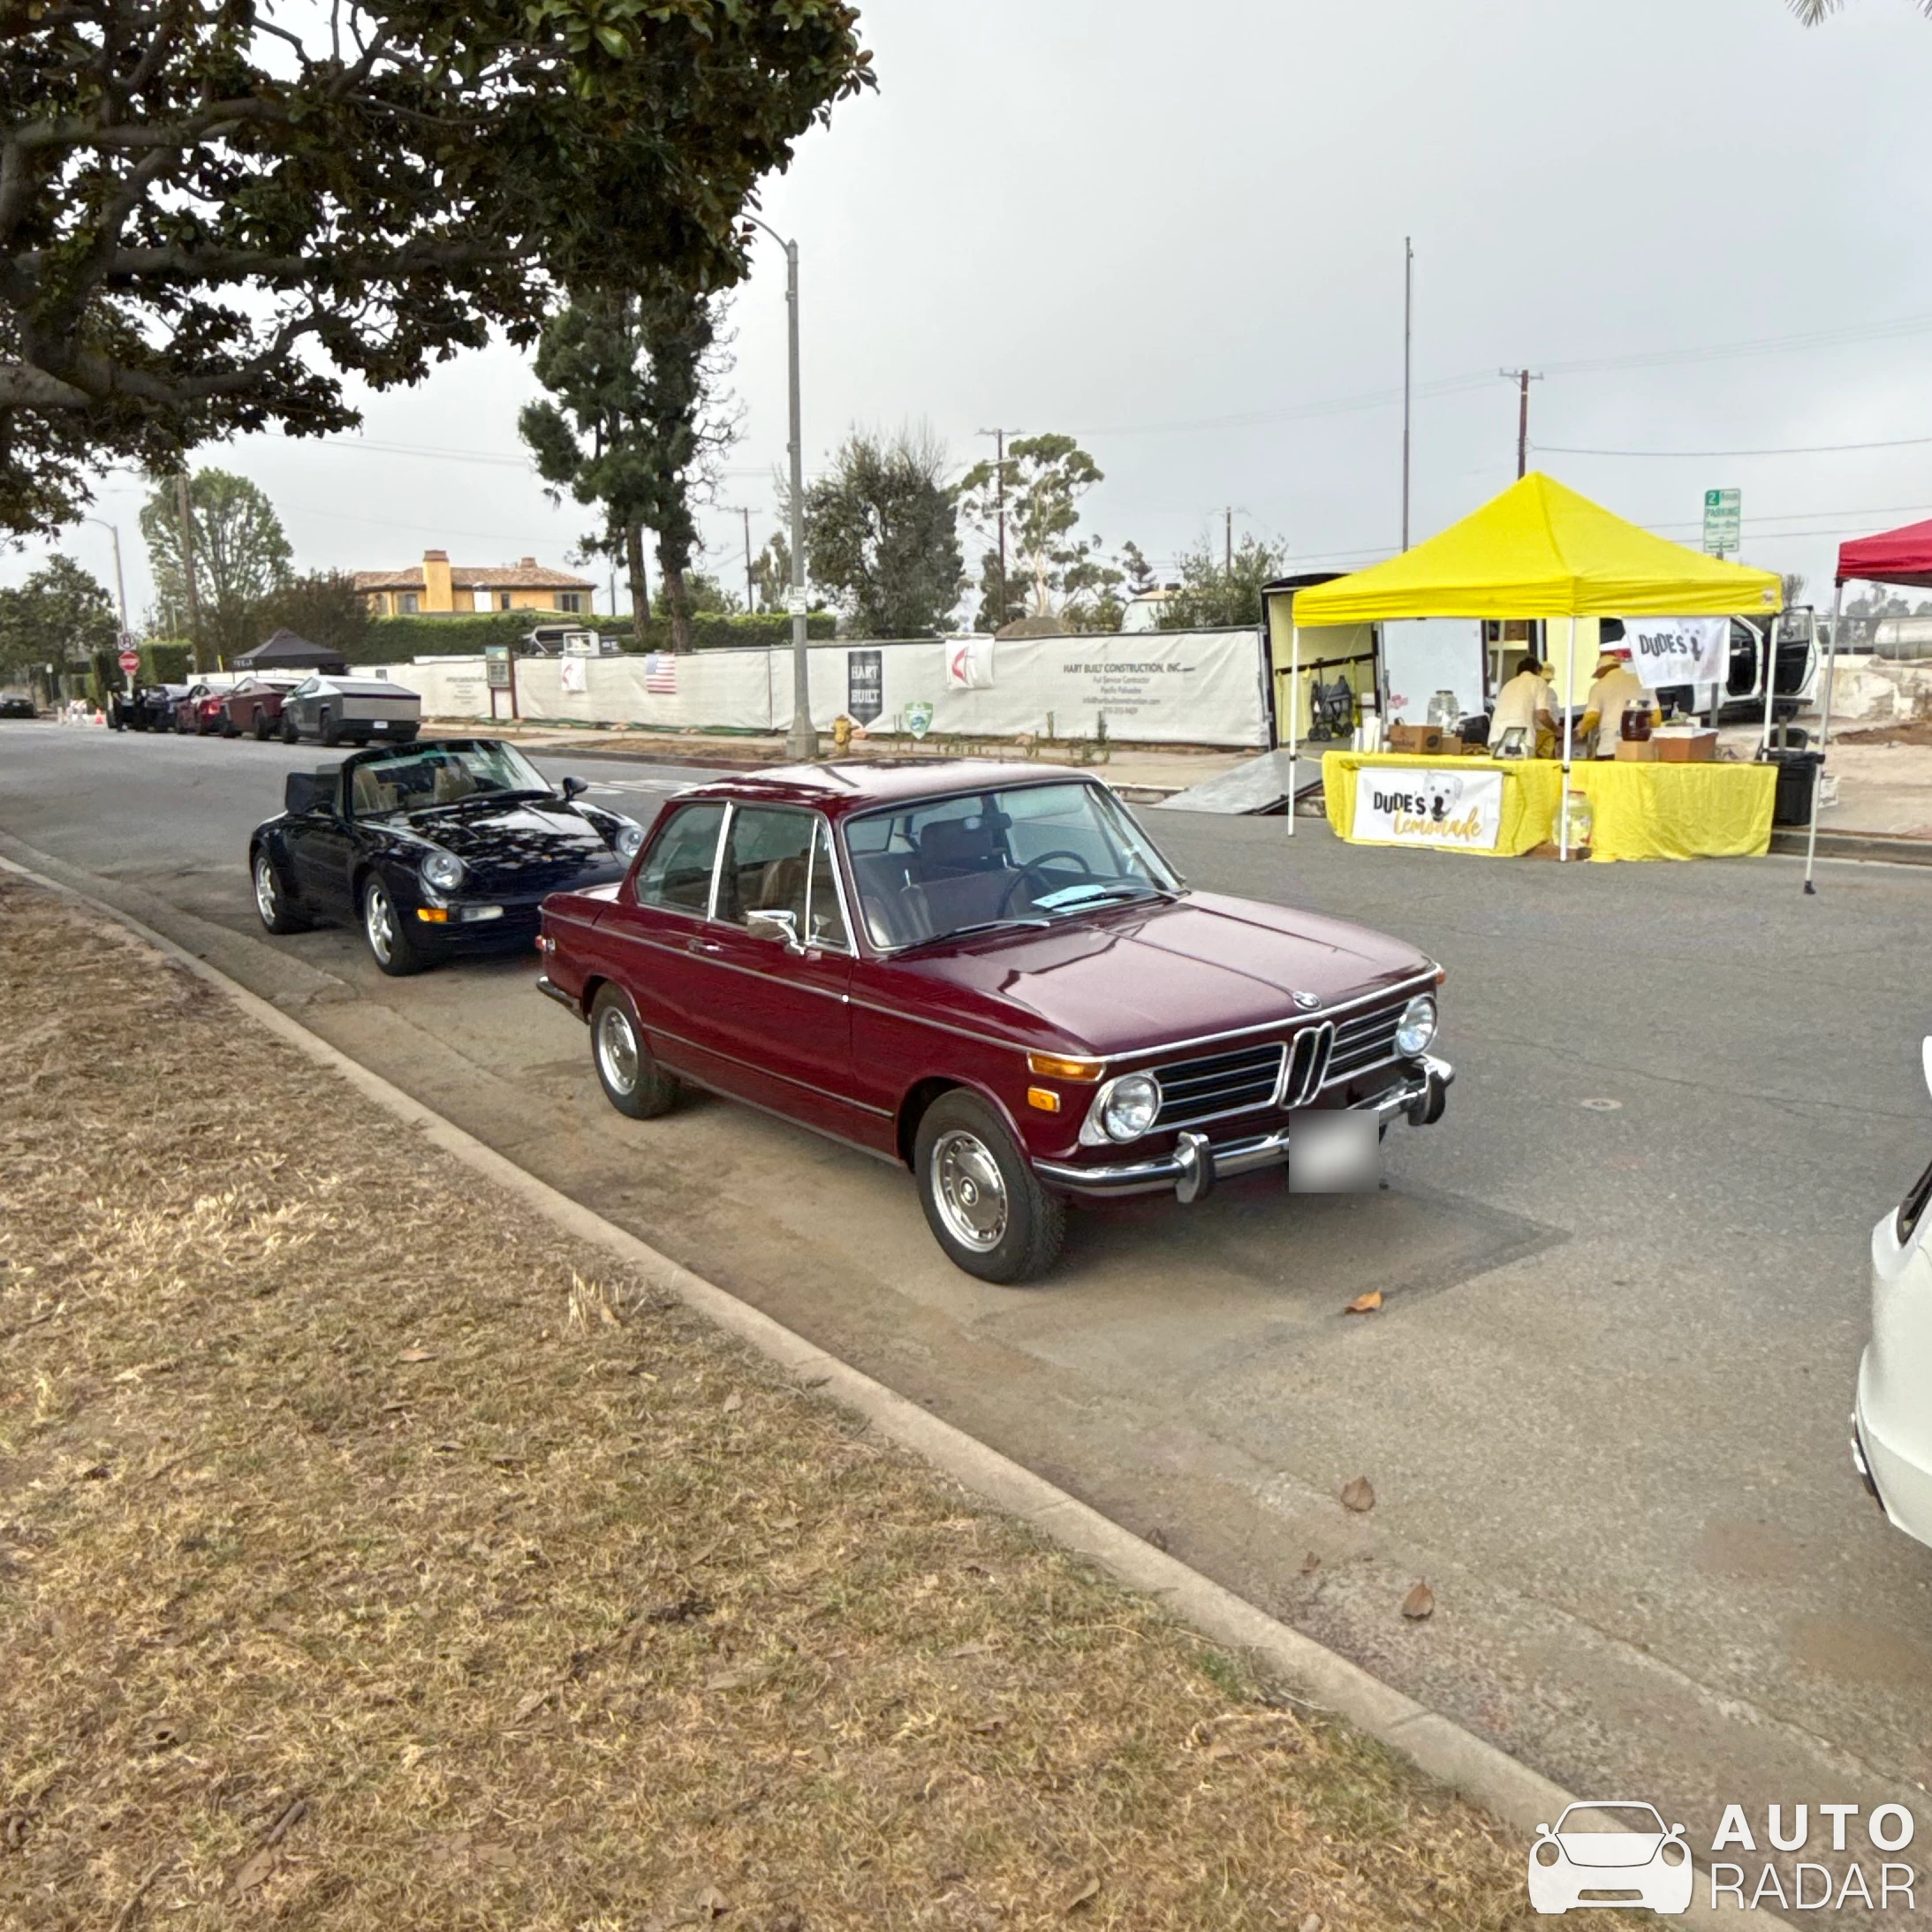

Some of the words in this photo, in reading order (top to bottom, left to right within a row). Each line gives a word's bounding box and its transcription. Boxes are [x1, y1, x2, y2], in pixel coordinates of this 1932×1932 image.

[1708, 491, 1717, 504] 2
[1639, 630, 1688, 657] DUDE'S
[851, 665, 879, 680] HART
[1064, 663, 1082, 673] HART
[1084, 663, 1103, 673] BUILT
[851, 689, 880, 703] BUILT
[1374, 791, 1427, 815] DUDE'S
